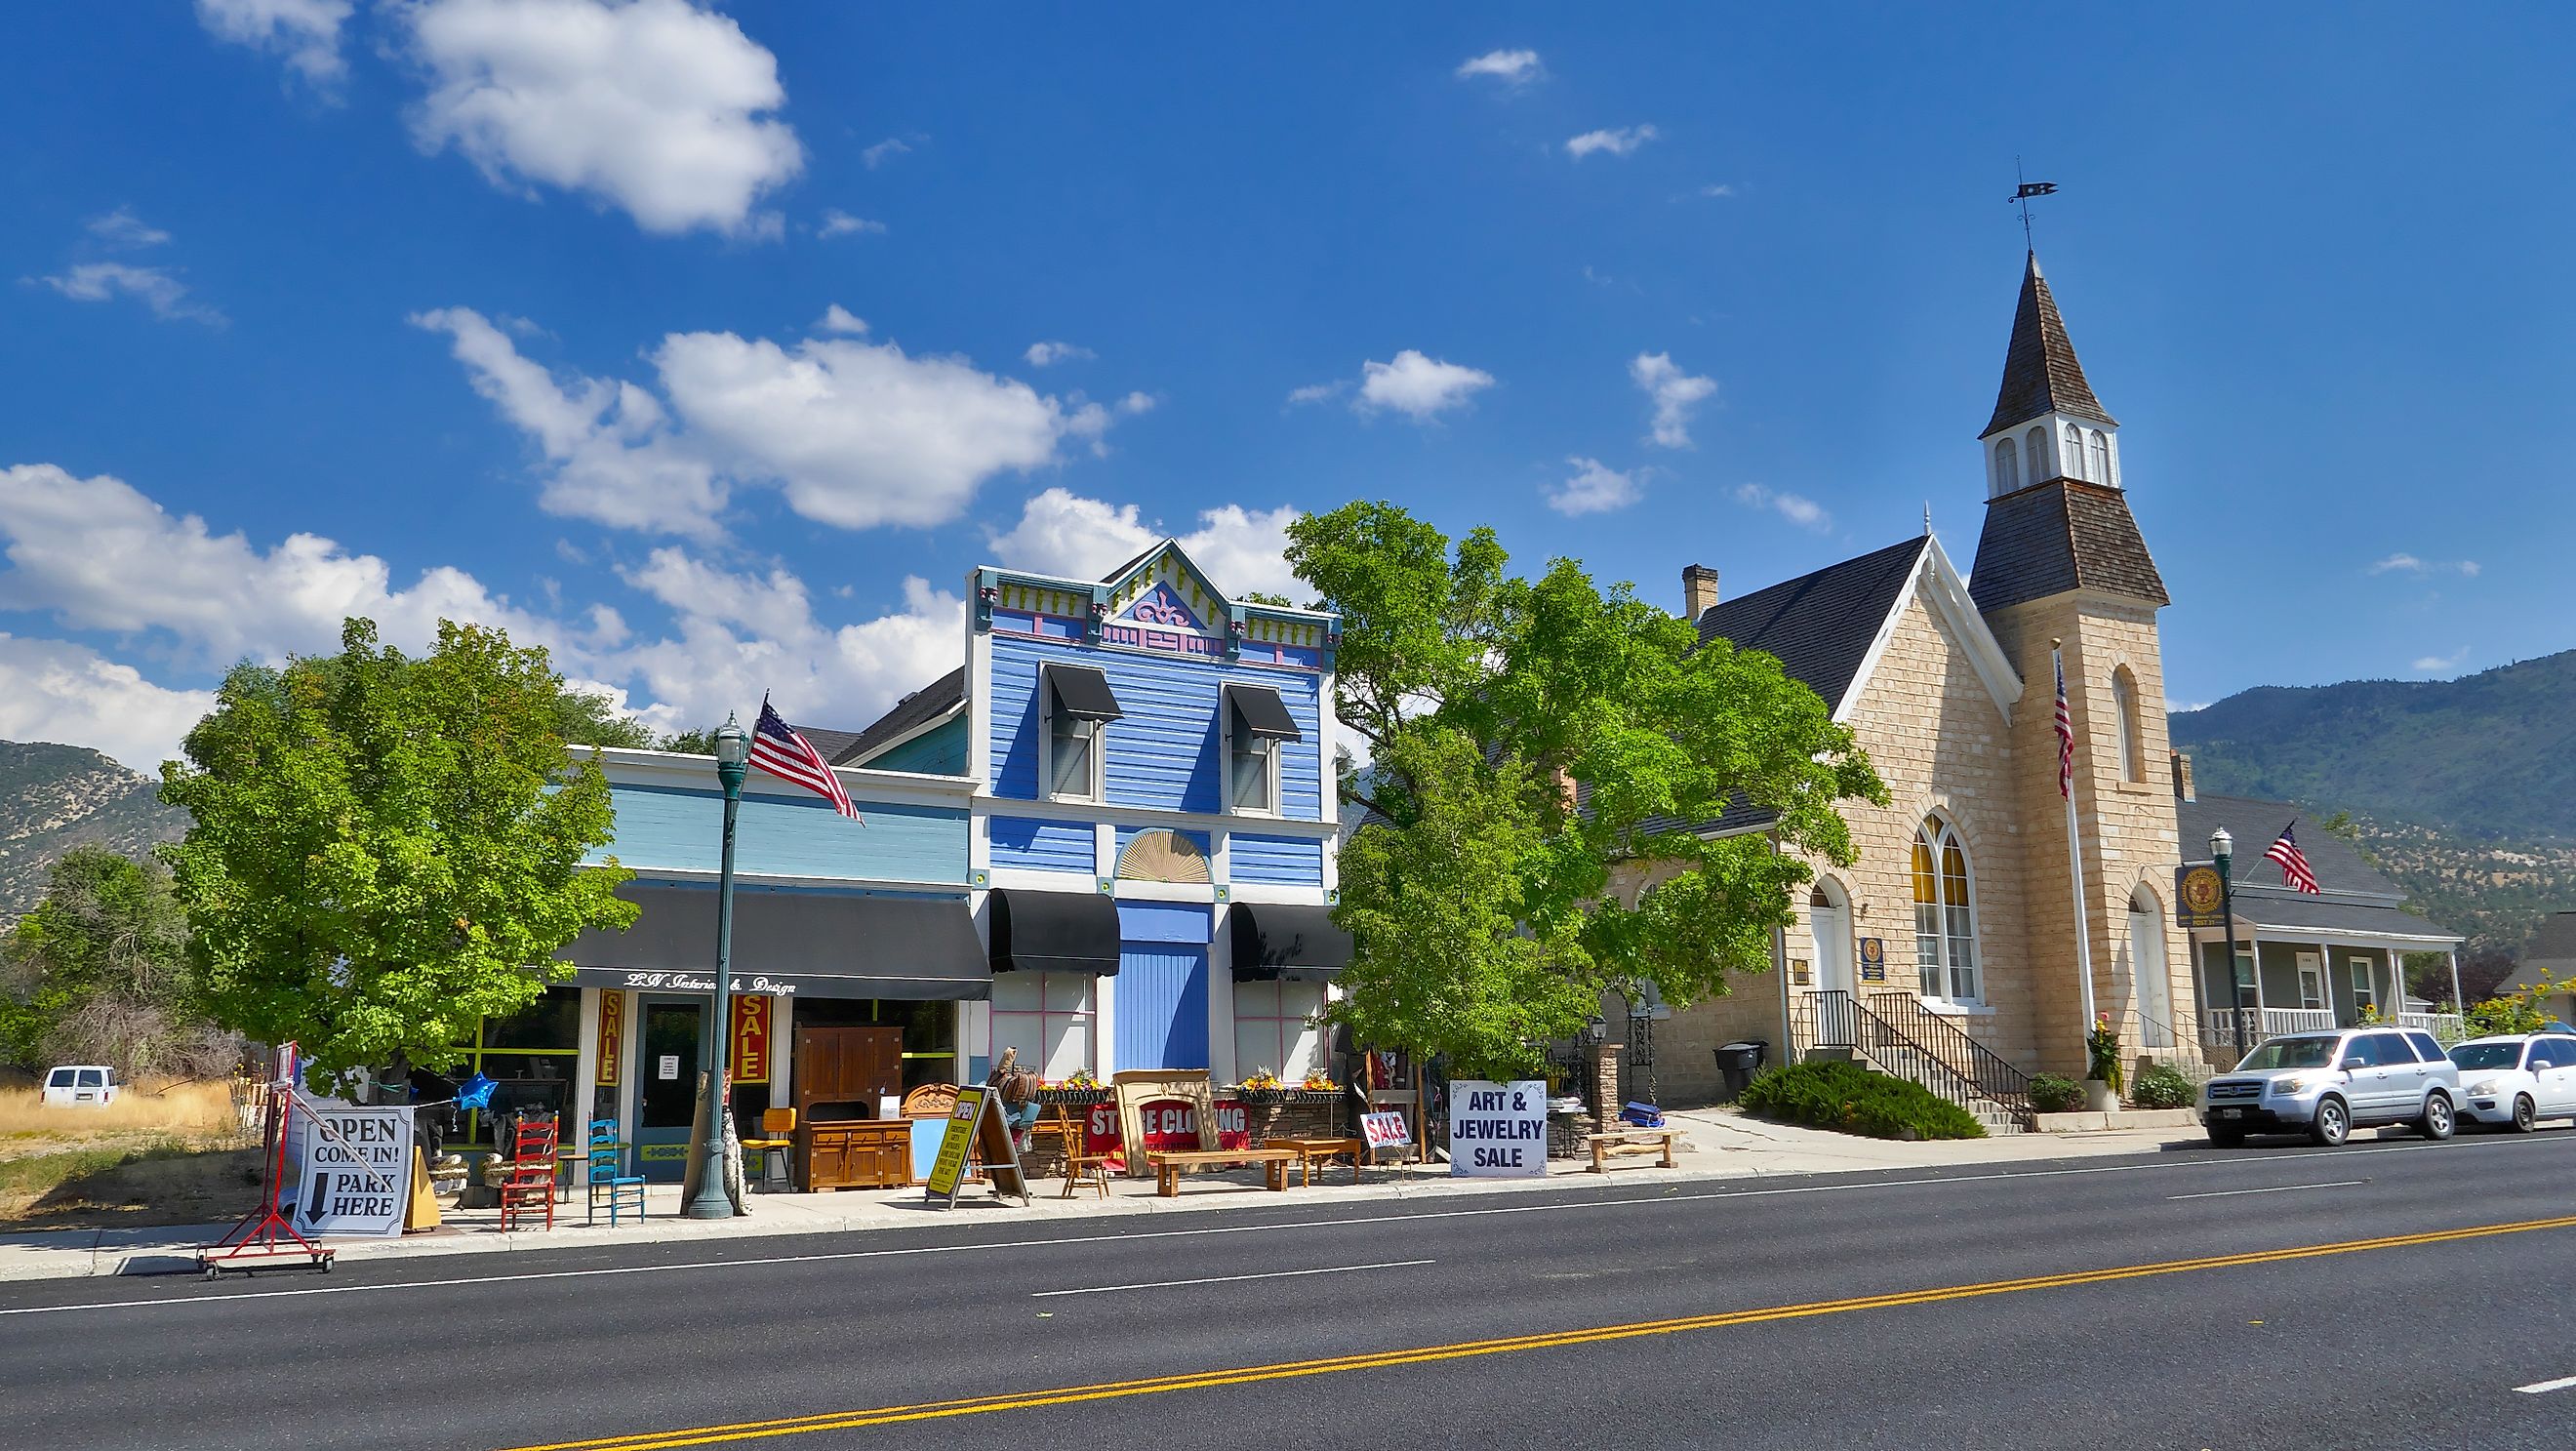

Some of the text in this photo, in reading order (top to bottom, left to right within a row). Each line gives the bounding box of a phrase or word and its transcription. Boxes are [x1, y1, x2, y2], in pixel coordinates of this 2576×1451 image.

[624, 973, 796, 995] LN Interio & Design
[603, 995, 618, 1080] SALE
[741, 994, 761, 1078] SALE
[954, 1102, 976, 1119] OPEN
[1469, 1091, 1527, 1111] ART &
[319, 1118, 396, 1143] OPEN
[1092, 1109, 1157, 1135] STE
[1367, 1116, 1406, 1143] SALE
[1453, 1119, 1544, 1140] JEWELRY
[315, 1147, 399, 1163] COME IN!
[1474, 1147, 1522, 1167] SALE
[336, 1174, 396, 1193] PARK
[332, 1196, 394, 1217] HERE
